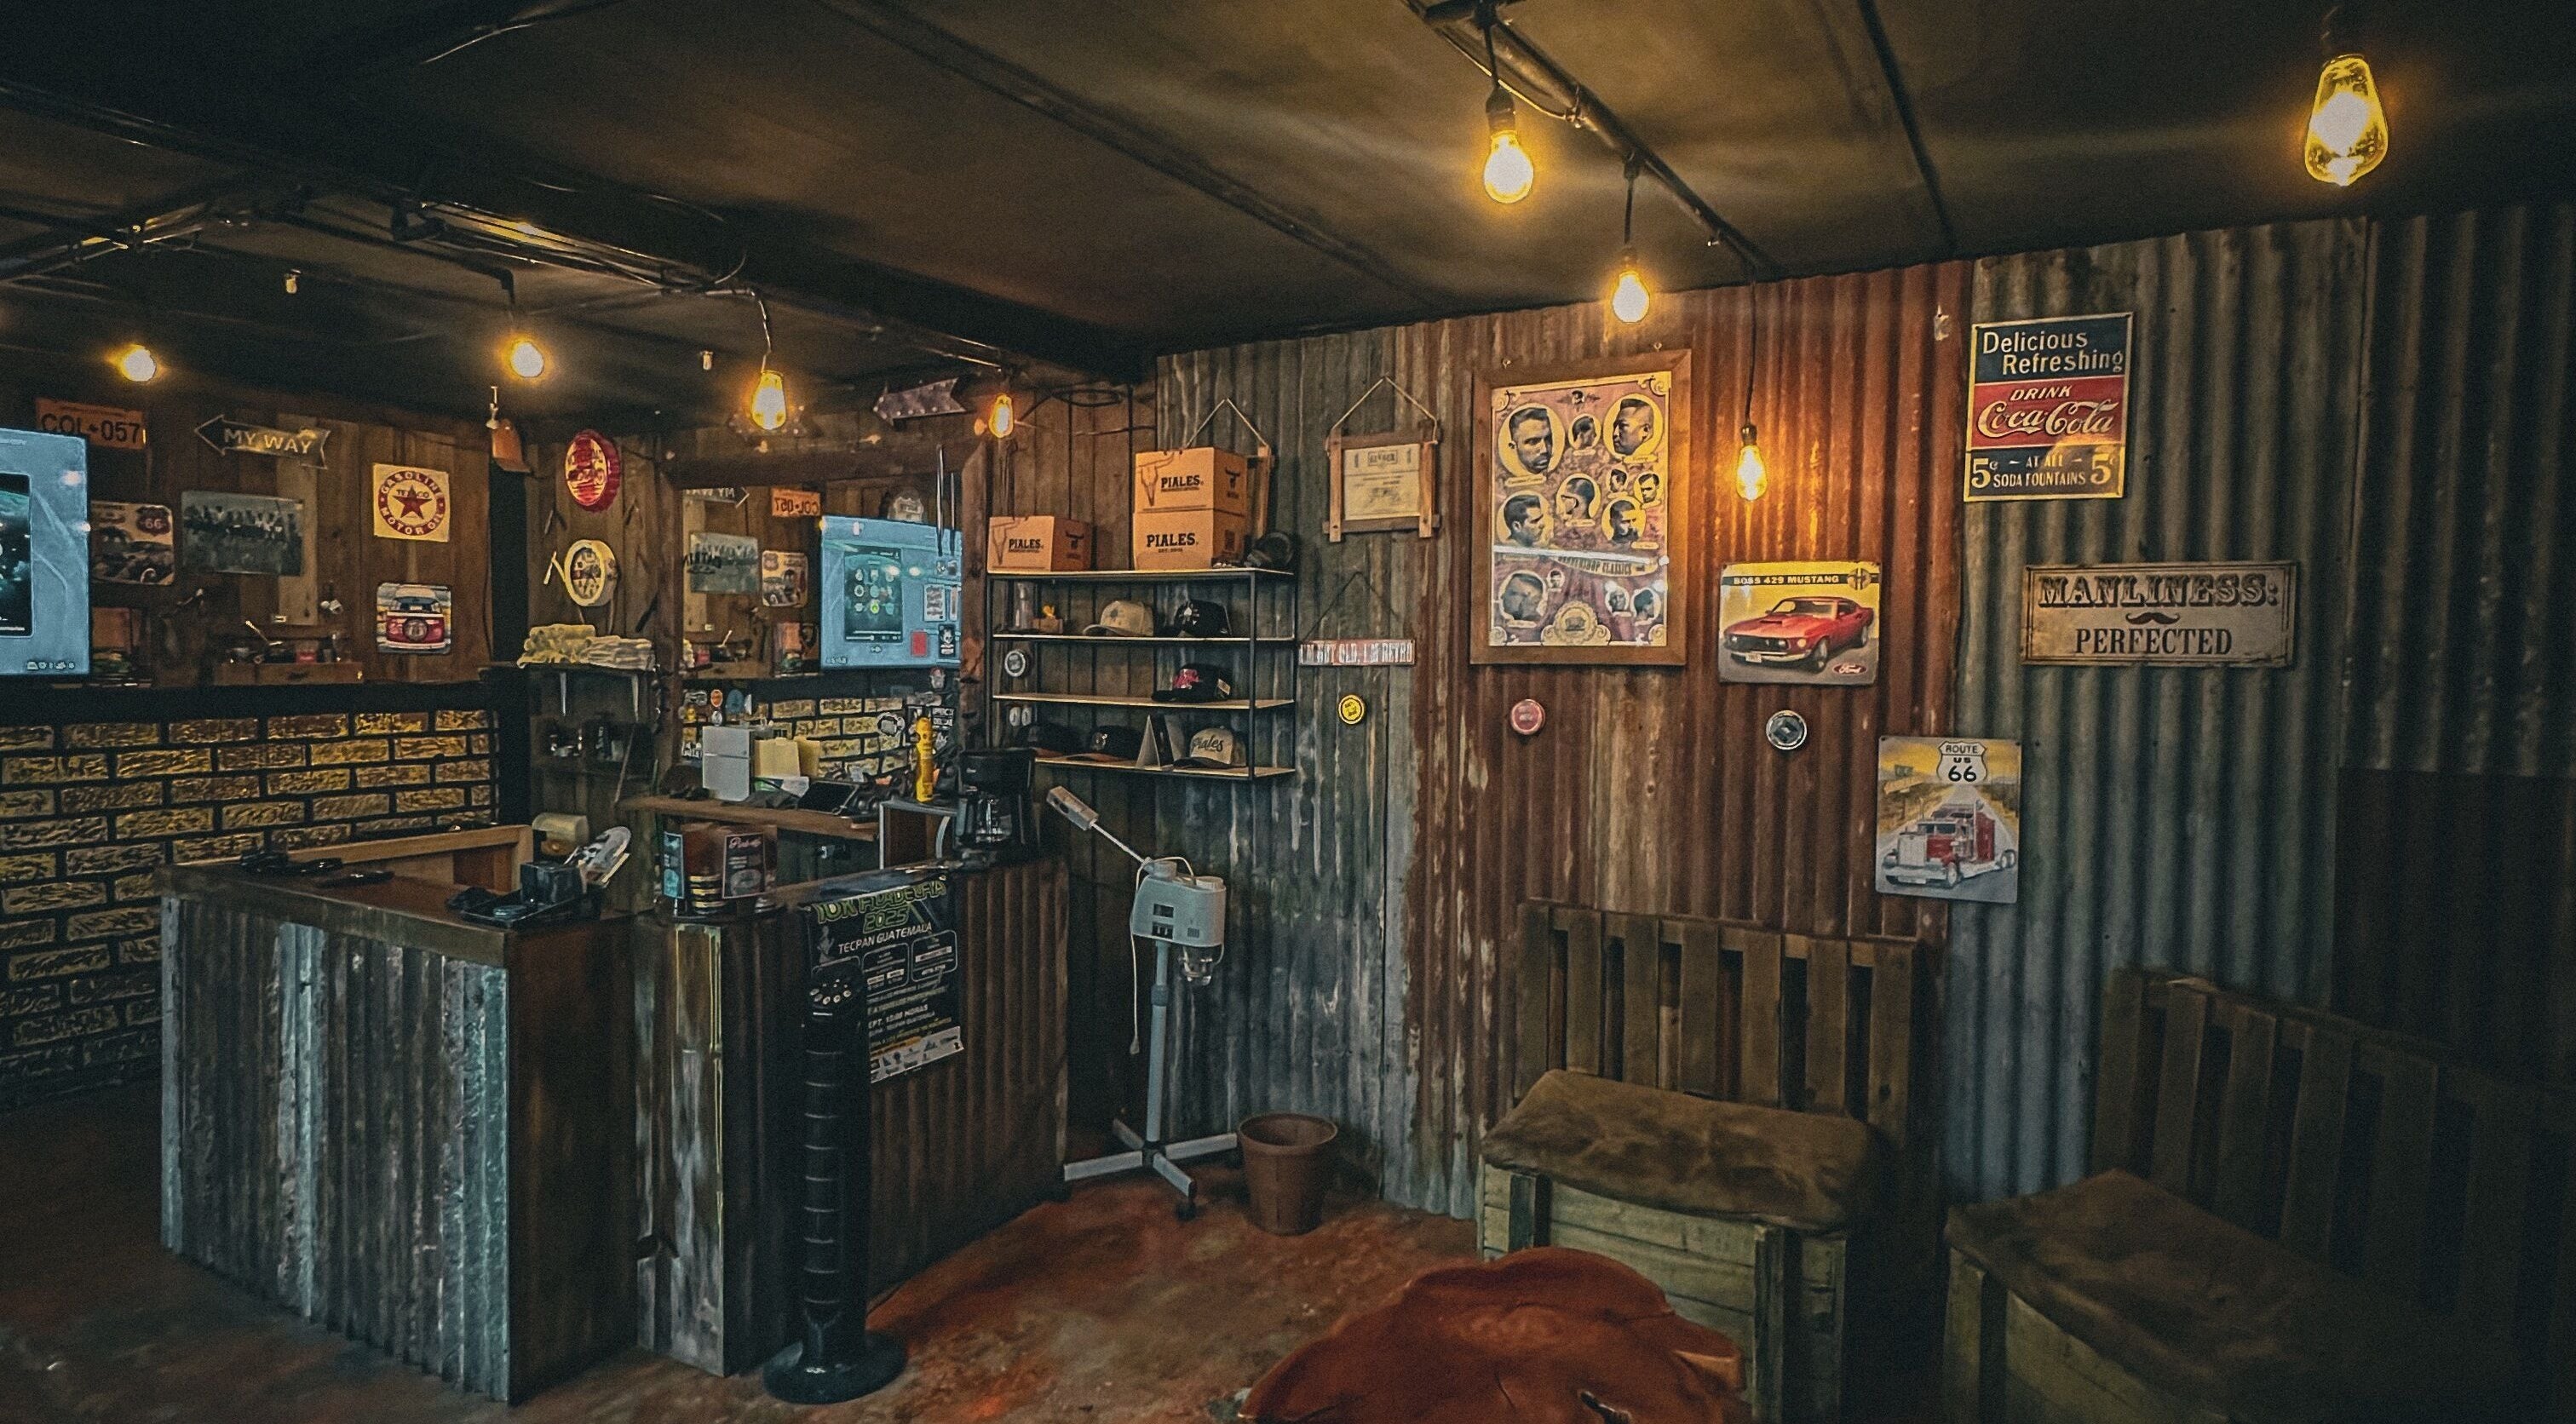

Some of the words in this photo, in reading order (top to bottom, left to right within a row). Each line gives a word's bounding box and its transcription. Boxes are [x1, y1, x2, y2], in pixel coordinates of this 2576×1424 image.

[1983, 330, 2088, 354] Delicious
[2002, 349, 2123, 375] Refreshing
[2010, 385, 2072, 400] DRINK
[224, 428, 256, 445] MY
[264, 434, 312, 454] WAY
[2026, 456, 2038, 468] AT
[2044, 453, 2063, 467] ALL
[381, 471, 444, 497] GASOLINE
[1161, 474, 1200, 488] PIALES
[1993, 474, 2022, 488] SODA
[2025, 471, 2086, 486] FOUNTAINS
[396, 489, 429, 499] TECO
[145, 518, 163, 529] 66
[381, 507, 424, 535] MOTOR
[428, 513, 444, 529] OIL
[1009, 538, 1041, 549] PIALES
[1147, 532, 1196, 548] PIALES
[1734, 577, 1761, 585] BOSS
[1763, 576, 1784, 584] 429
[1787, 575, 1839, 583] MUSTANG
[2037, 572, 2279, 607] MANLINESS:
[2075, 628, 2232, 655] PERFECTED
[1382, 642, 1413, 663] RETRO
[1946, 744, 1978, 754] ROUTE
[1948, 766, 1976, 782] 66
[812, 897, 858, 924] 10K
[863, 905, 910, 933] 2025
[877, 922, 932, 943] GUATEMALA
